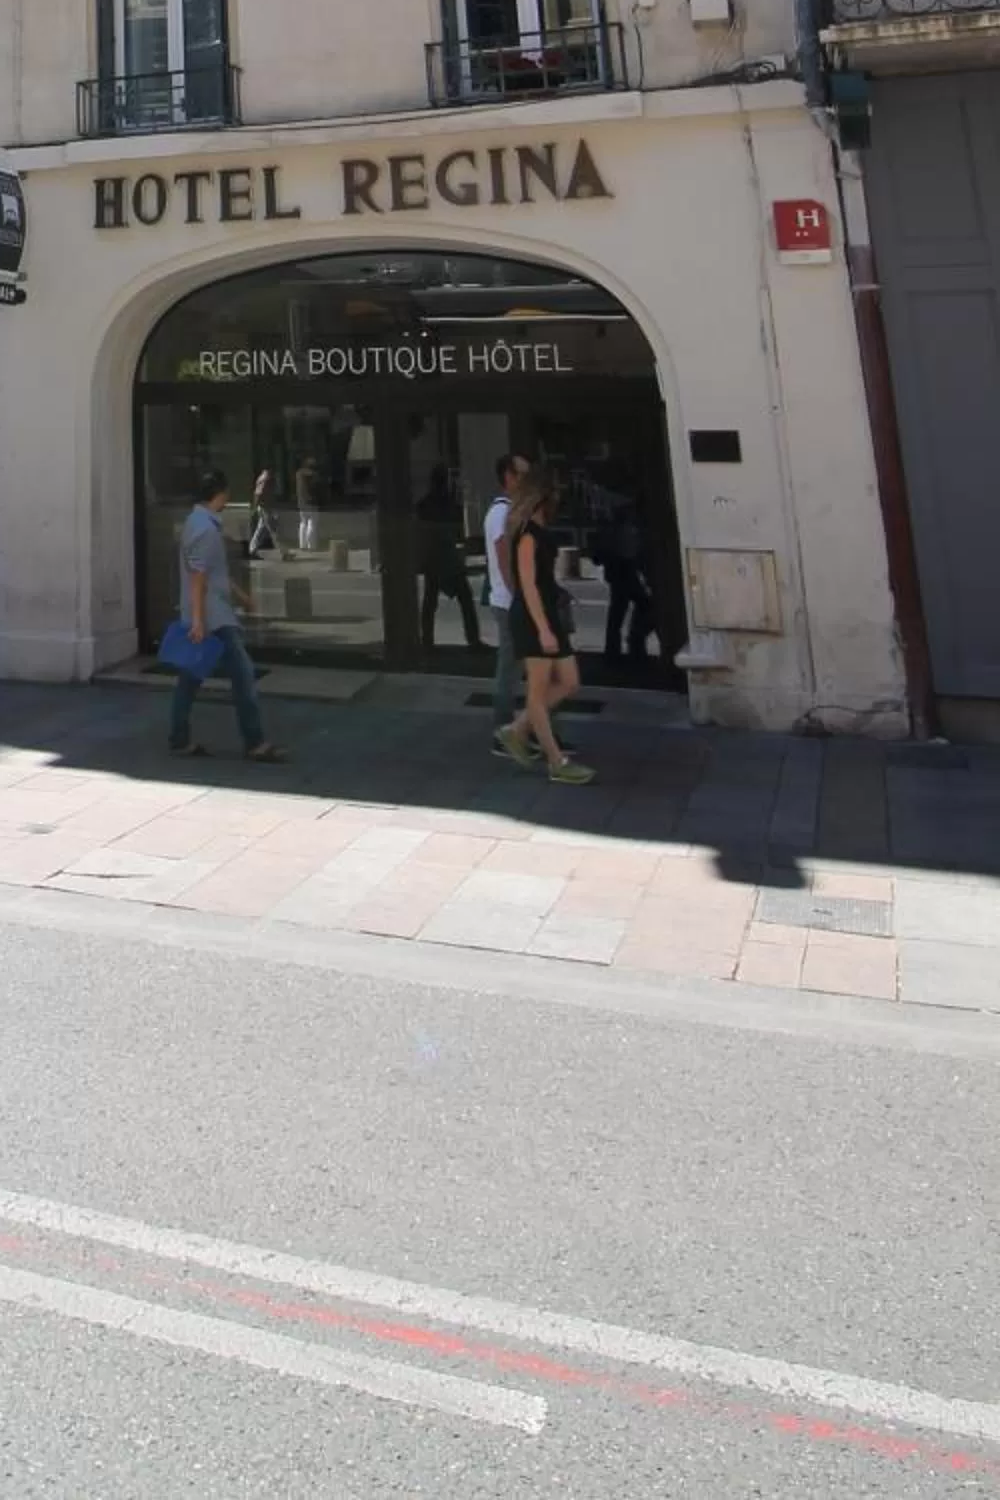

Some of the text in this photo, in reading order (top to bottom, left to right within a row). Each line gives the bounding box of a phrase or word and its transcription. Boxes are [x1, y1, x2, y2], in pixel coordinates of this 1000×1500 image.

[93, 138, 616, 228] HOTEL REGINA
[199, 339, 574, 378] REGINA BOUTIQUE HÔTEL
